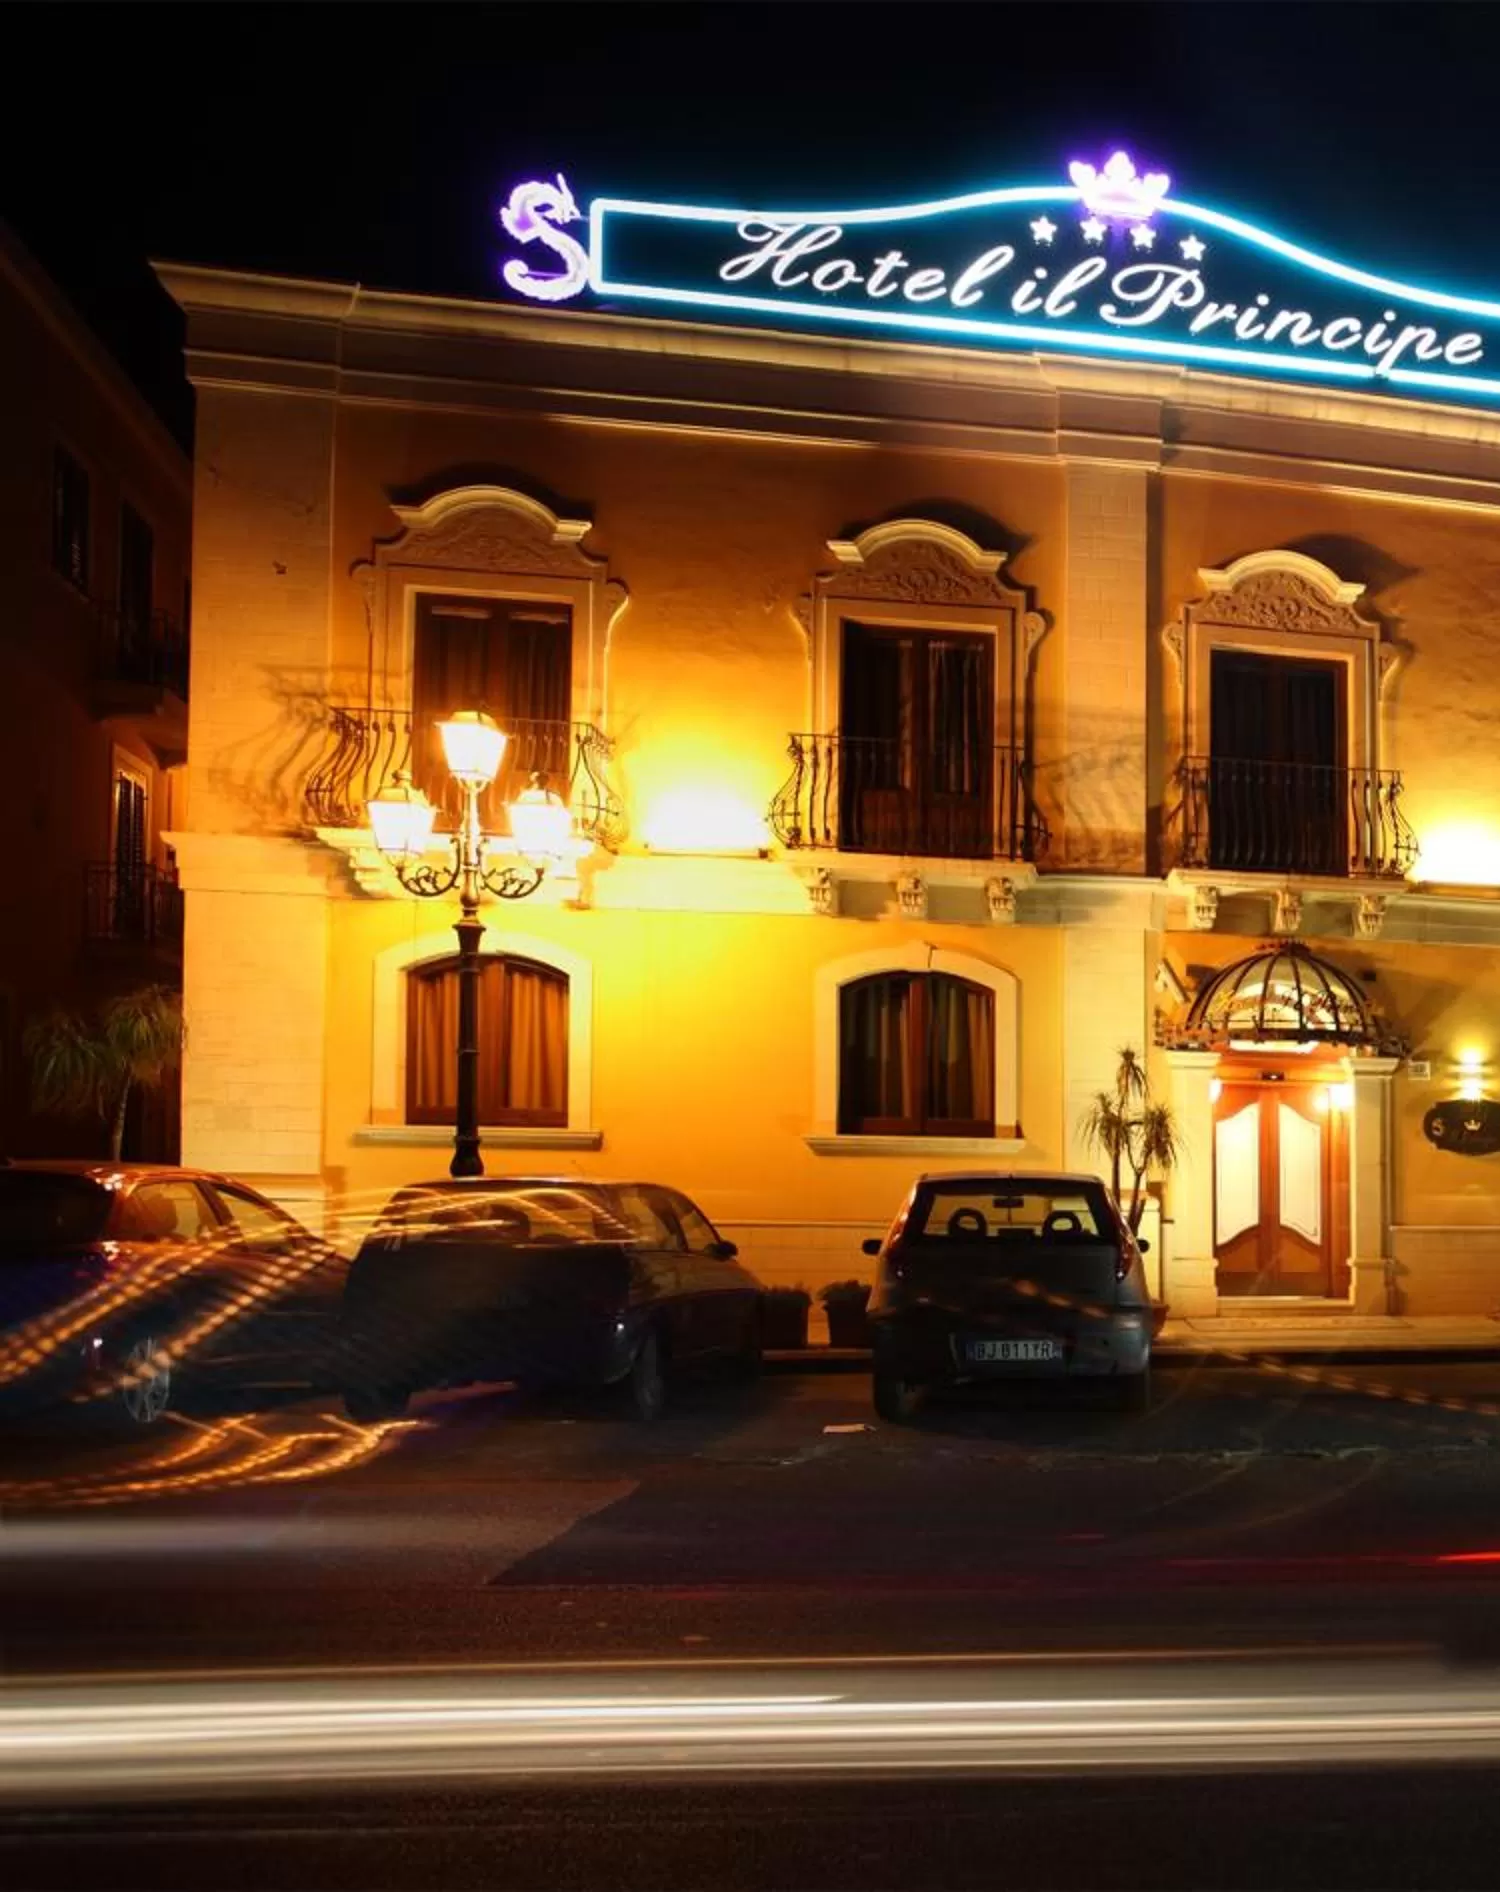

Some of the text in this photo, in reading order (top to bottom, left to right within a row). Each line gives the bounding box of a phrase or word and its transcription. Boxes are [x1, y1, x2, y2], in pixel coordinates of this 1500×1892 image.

[719, 216, 1484, 375] Hotel il Principe
